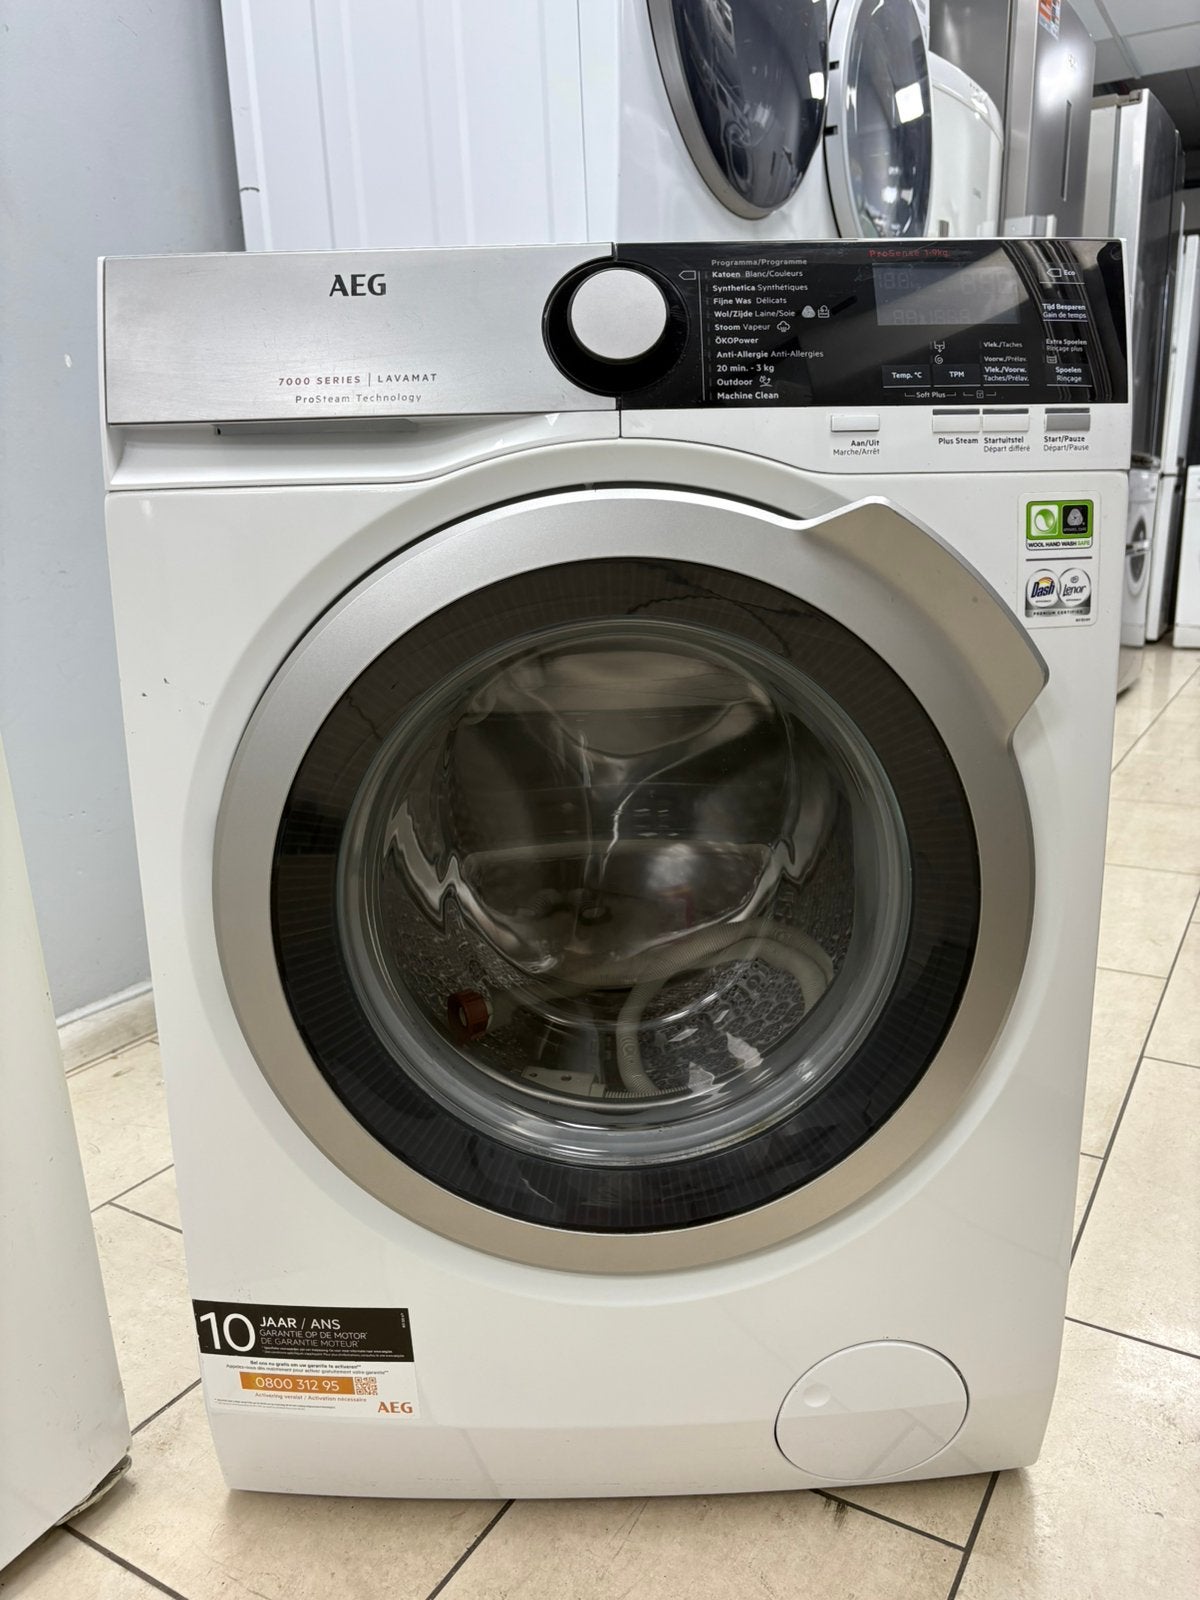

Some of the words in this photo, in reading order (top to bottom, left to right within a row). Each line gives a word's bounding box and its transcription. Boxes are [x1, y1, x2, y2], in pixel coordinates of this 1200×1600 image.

[330, 274, 386, 296] AEG
[763, 364, 774, 373] kg
[279, 377, 310, 386] 7000
[316, 376, 361, 385] SERIES
[378, 373, 437, 383] LAVAMAT
[296, 394, 350, 403] ProSteam
[356, 393, 421, 403] Technology
[851, 439, 880, 447] Aan/Uit
[1044, 435, 1085, 443] Start/Pauze
[984, 445, 1005, 454] Départ
[1044, 443, 1089, 452] Départ/Pause
[1031, 581, 1055, 598] Dash
[1062, 584, 1086, 596] Lenor
[260, 1316, 297, 1329] JAAR
[301, 1318, 306, 1330] /
[311, 1319, 341, 1330] ANS
[200, 1312, 256, 1352] 10
[260, 1329, 303, 1338] GARANTIE
[255, 1377, 293, 1390] 0800
[297, 1379, 321, 1390] 312
[323, 1380, 340, 1391] 95
[378, 1402, 413, 1413] AEG
